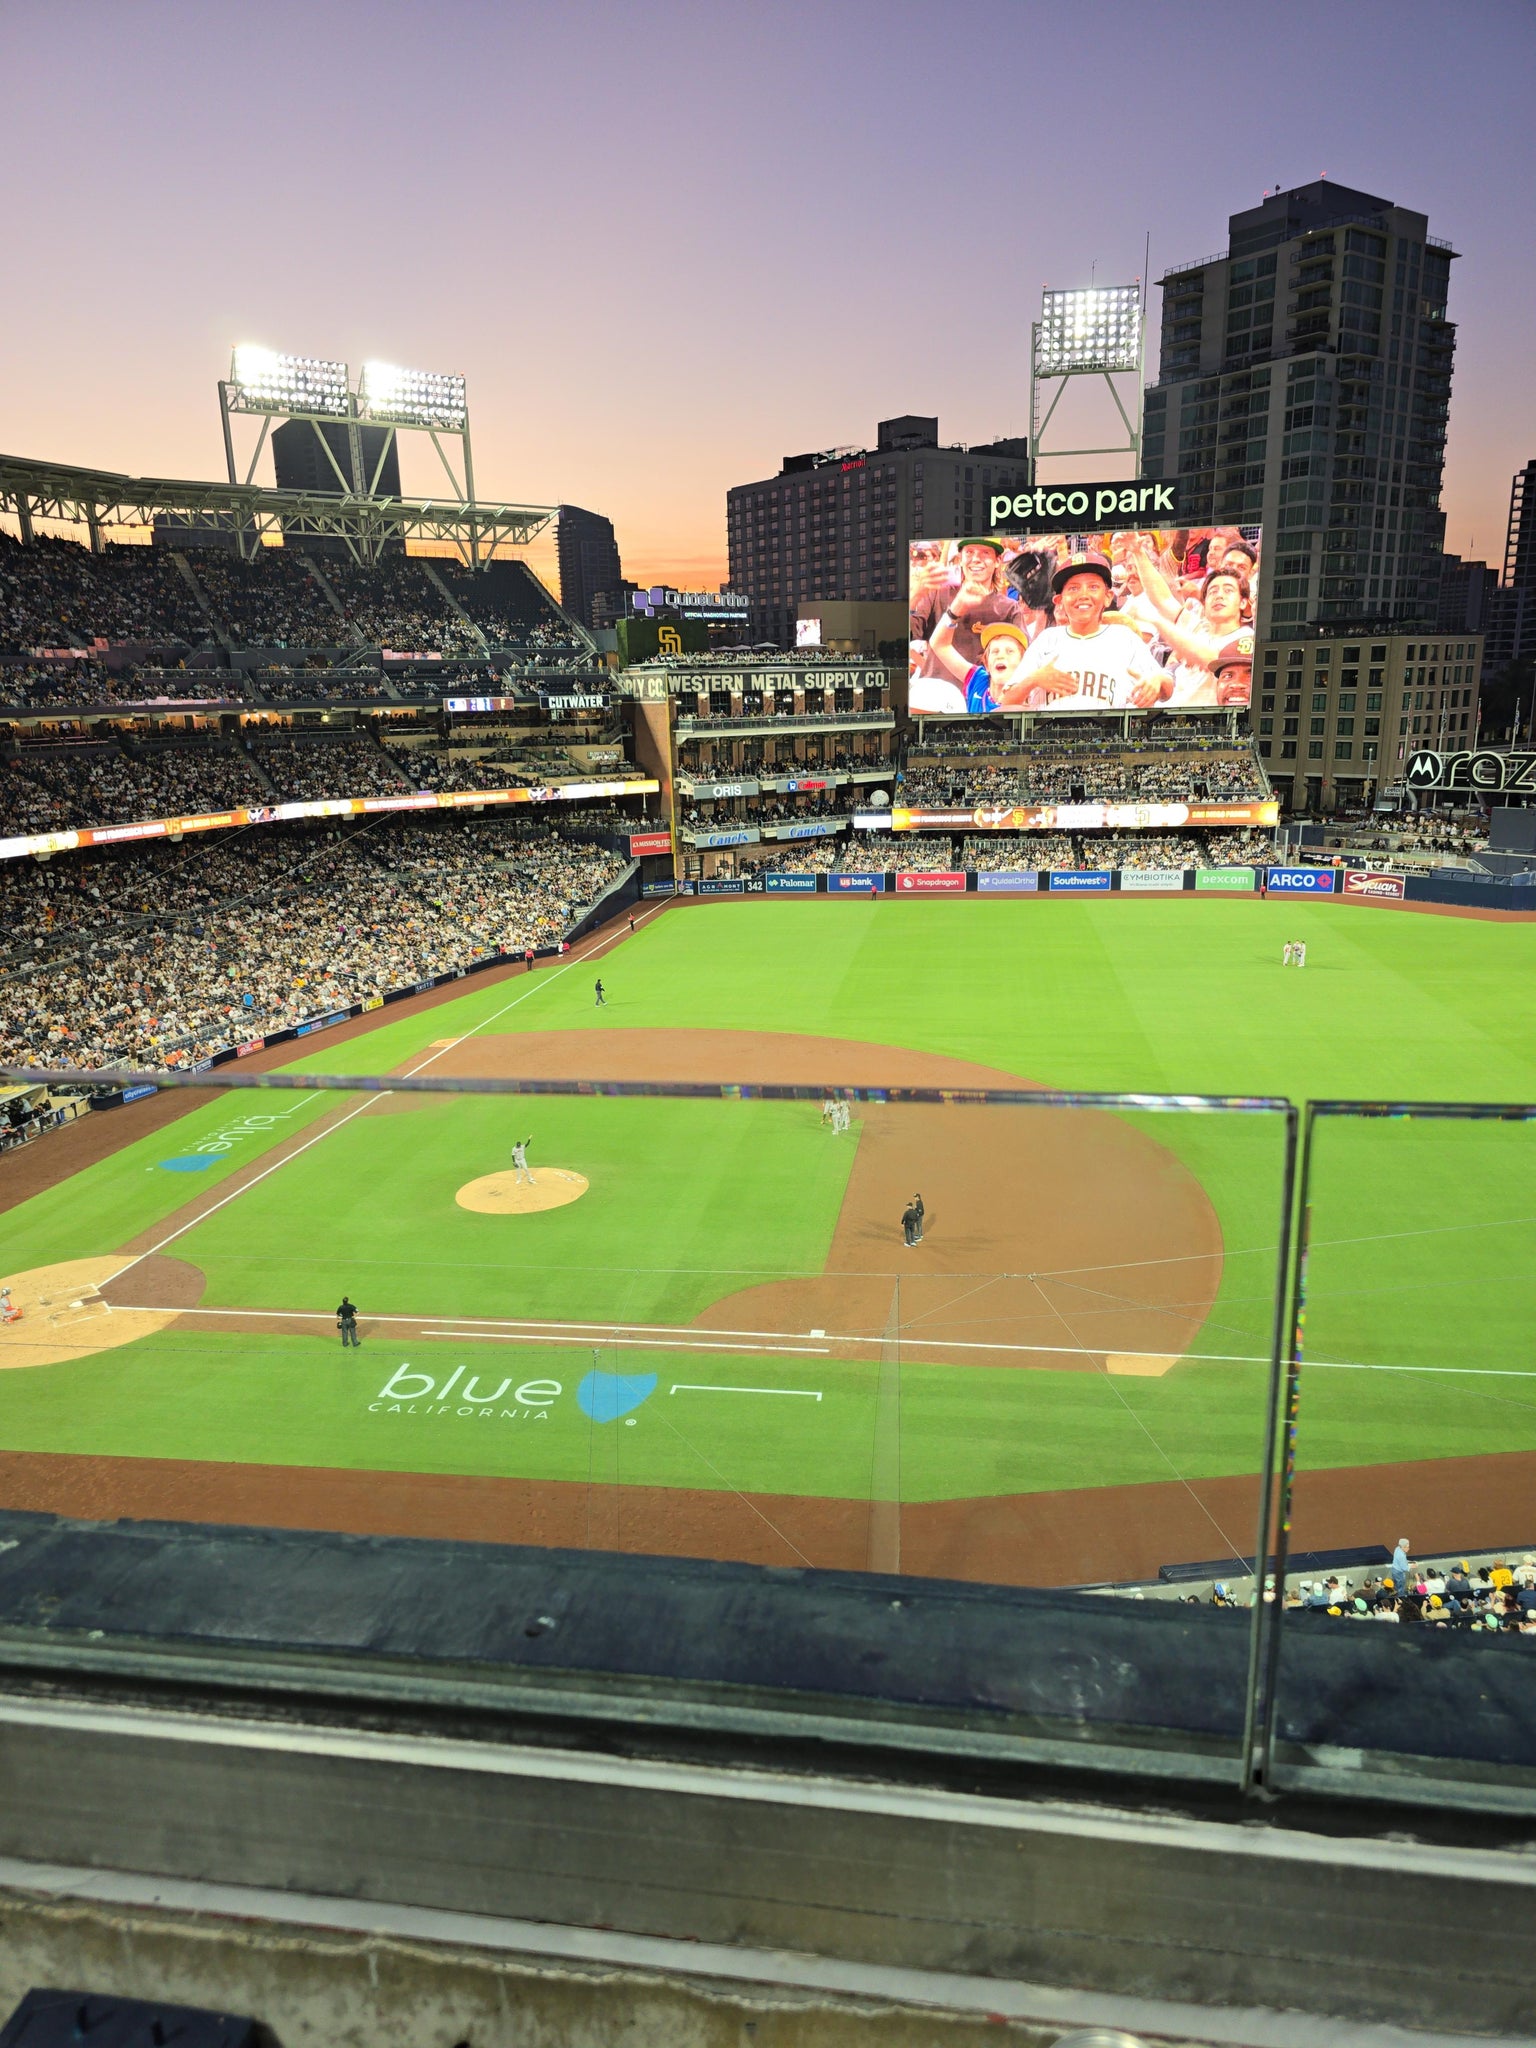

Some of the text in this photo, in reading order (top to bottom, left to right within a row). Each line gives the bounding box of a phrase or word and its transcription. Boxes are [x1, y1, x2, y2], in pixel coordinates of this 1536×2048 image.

[990, 484, 1175, 527] petco park
[665, 591, 749, 609] QuidelOrtho
[668, 671, 888, 692] WESTERN METAL SUPPLY CO.
[549, 695, 603, 708] CUTWATER
[713, 785, 742, 797] ORIS
[165, 818, 181, 835] VS
[789, 824, 826, 838] Canel's
[708, 832, 749, 847] Canel's
[747, 881, 763, 892] 342
[780, 878, 814, 887] Palomar
[917, 878, 959, 888] Snapdragon
[1053, 876, 1100, 886] Southwest
[1269, 873, 1316, 888] ARCO
[1348, 873, 1398, 894] Sycuan
[377, 1363, 563, 1406] blue
[368, 1402, 548, 1420] CALIFORNIA
